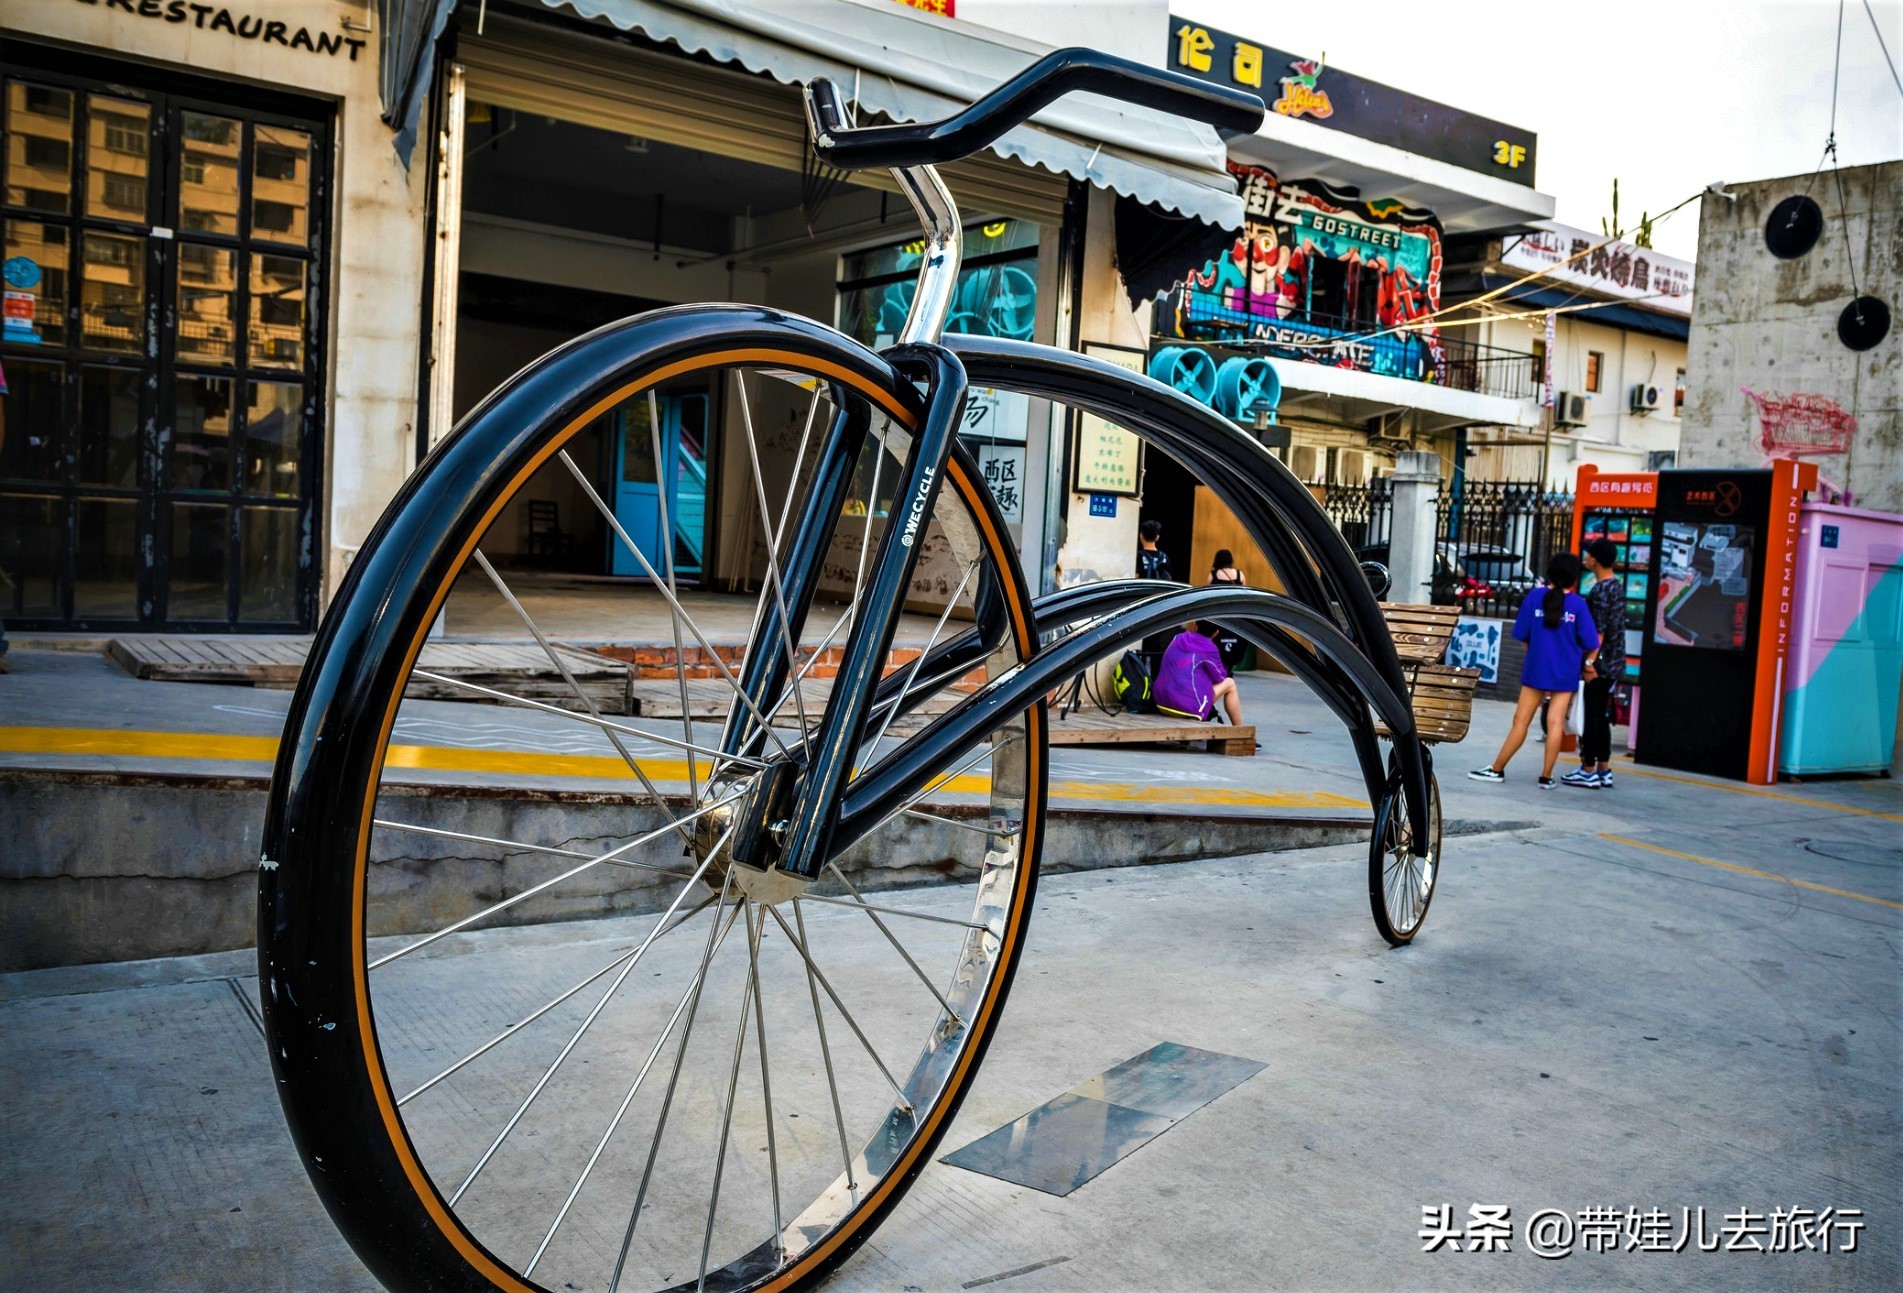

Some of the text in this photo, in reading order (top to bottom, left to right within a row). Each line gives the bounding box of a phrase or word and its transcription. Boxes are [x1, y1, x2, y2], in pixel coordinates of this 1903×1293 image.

[1493, 140, 1527, 169] 3F
[1312, 215, 1401, 249] GOSTREET
[904, 466, 936, 534] WECYCLE
[1777, 496, 1798, 653] INFORMATION
